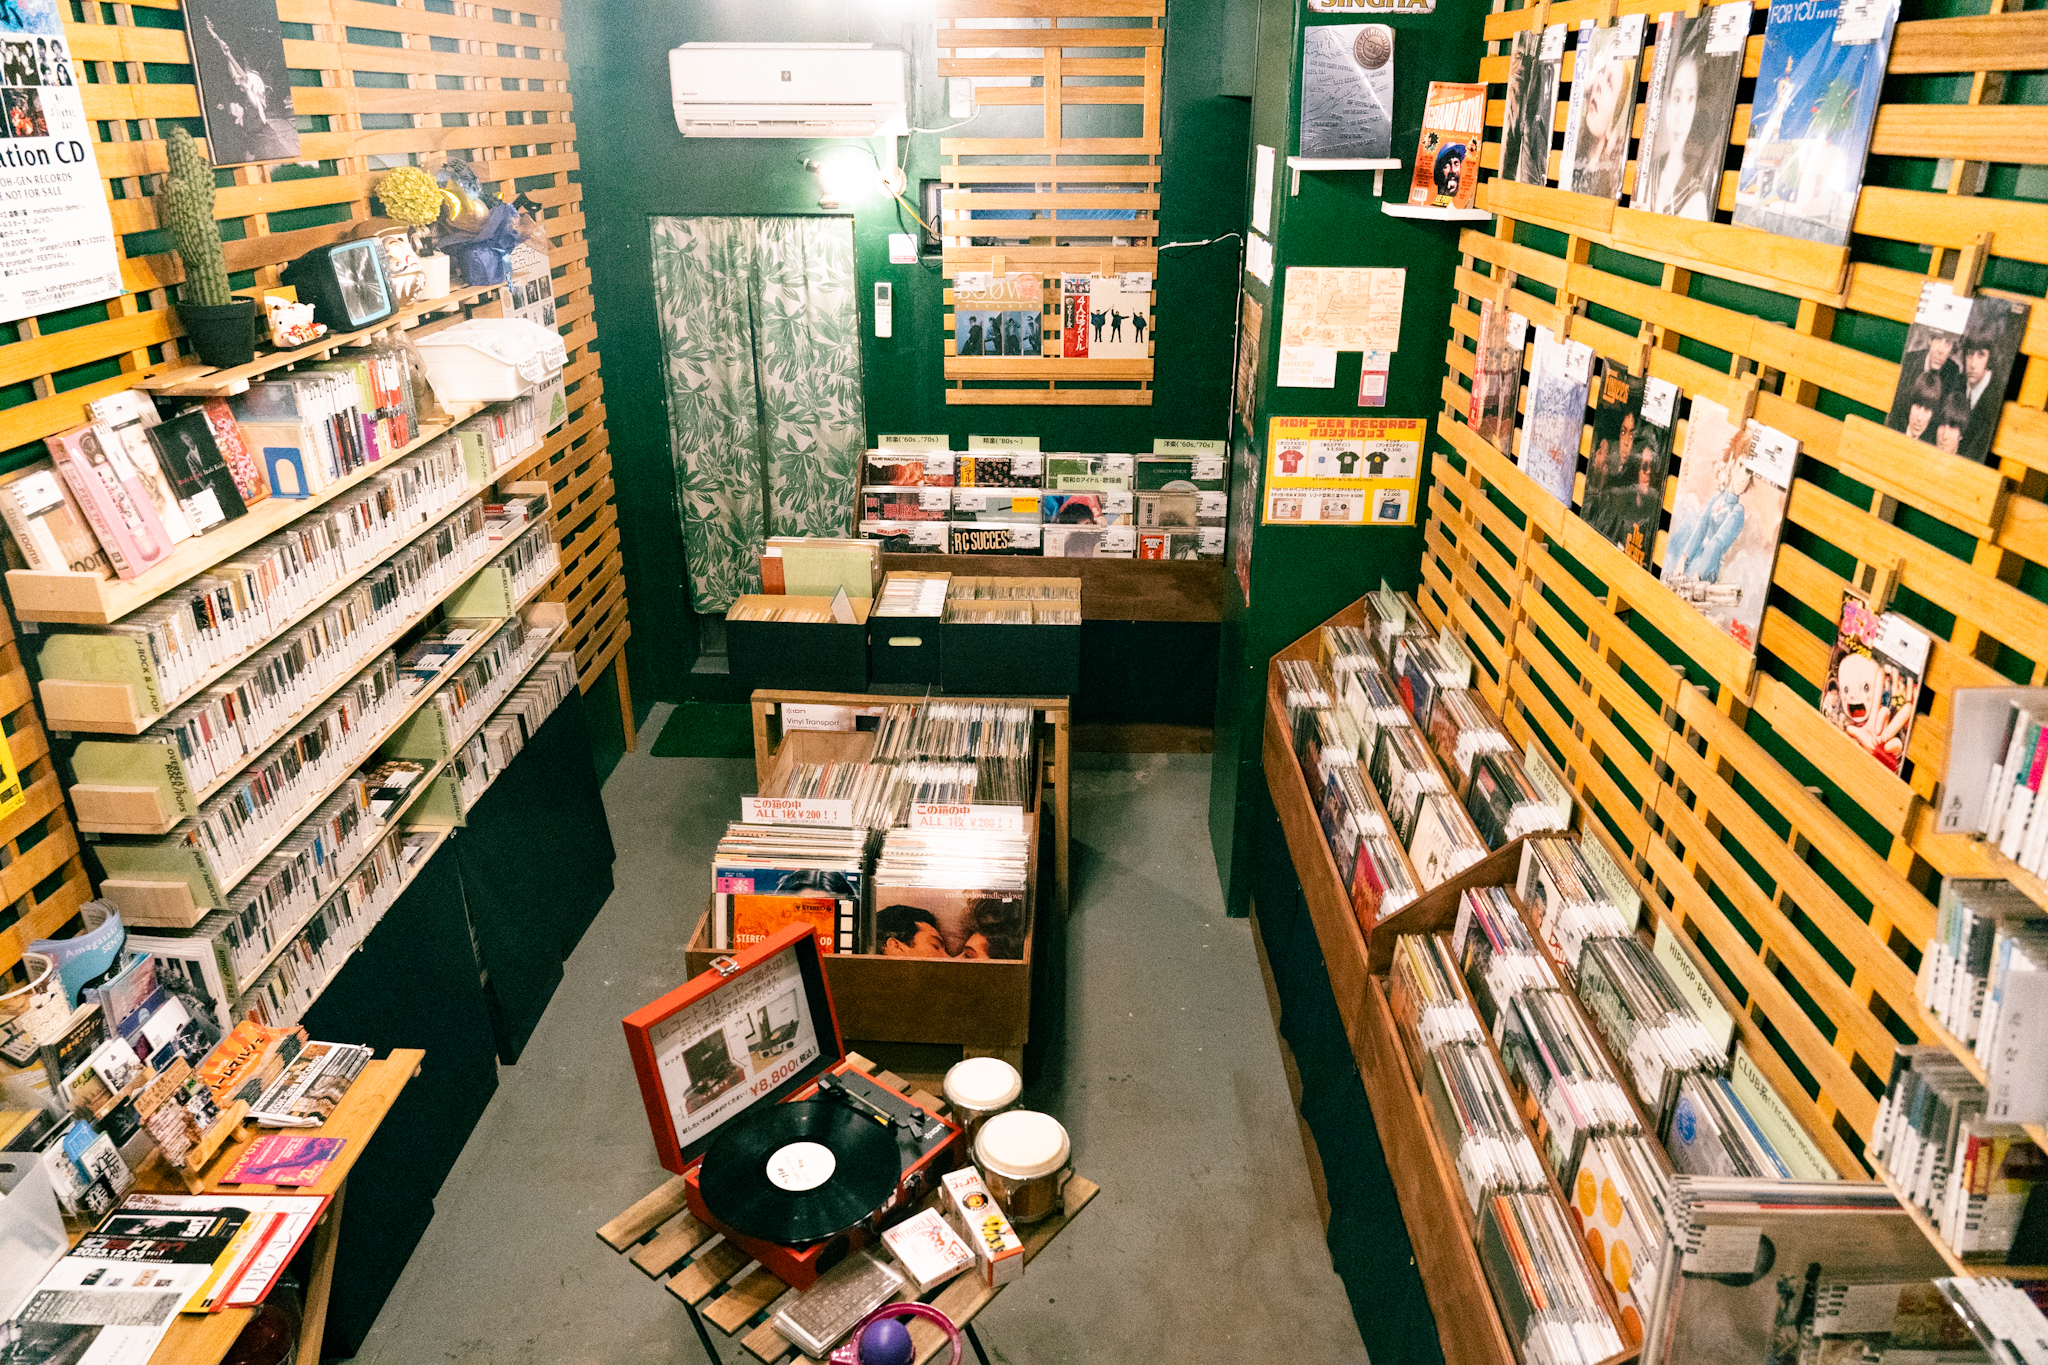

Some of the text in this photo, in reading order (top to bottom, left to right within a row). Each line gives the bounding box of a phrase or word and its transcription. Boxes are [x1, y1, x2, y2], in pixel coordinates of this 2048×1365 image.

[1770, 4, 1793, 24] FOR
[1794, 1, 1817, 21] YOU
[1426, 93, 1484, 134] GRAND ROYAL
[55, 140, 85, 164] CD
[33, 172, 73, 184] RECORDS
[24, 188, 40, 199] FOR
[42, 186, 62, 197] SALE
[1350, 419, 1417, 429] RECORDS
[19, 532, 42, 566] rooms
[970, 530, 1010, 550] SUCCES
[134, 638, 161, 714] J-ROCK & J-POP
[786, 717, 840, 727] Vinyl Transport
[450, 781, 462, 823] SOUNDTRACK
[753, 799, 802, 810] この箱の中
[917, 805, 971, 816] この箱の中
[756, 809, 778, 818] ALL
[920, 816, 945, 826] ALL
[65, 926, 118, 958] Amagasaki
[218, 949, 232, 978] HIPHOP
[296, 1054, 324, 1083] RECORDS
[664, 1054, 680, 1066] レッド
[750, 1059, 796, 1097] ¥8,800
[73, 1248, 146, 1259] 2023.12.03
